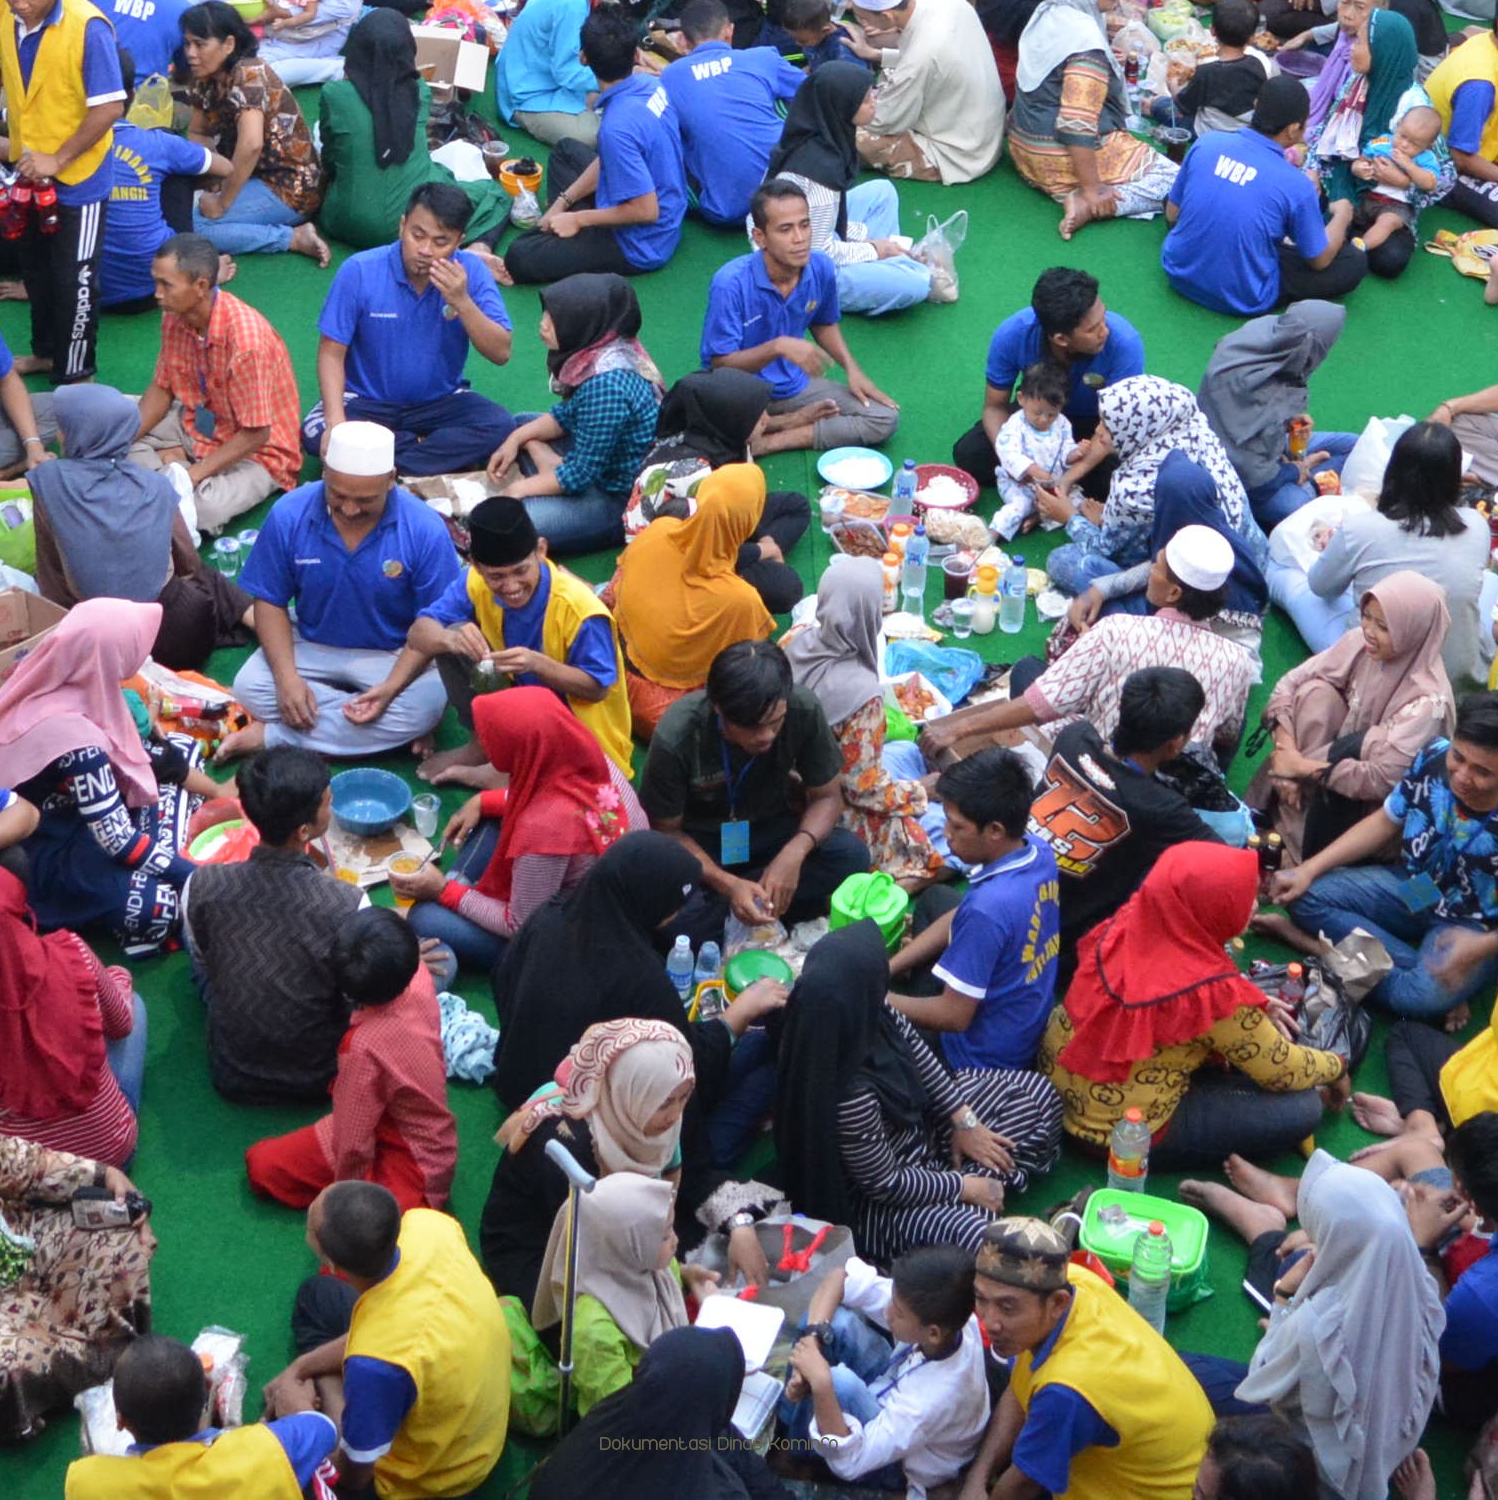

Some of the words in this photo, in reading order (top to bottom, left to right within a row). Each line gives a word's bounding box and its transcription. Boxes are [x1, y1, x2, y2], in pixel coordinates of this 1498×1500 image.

[691, 57, 732, 80] WBP
[113, 145, 153, 185] INAAN
[1214, 154, 1258, 186] WBP
[111, 185, 150, 200] ANGIL
[72, 286, 92, 340] adidas
